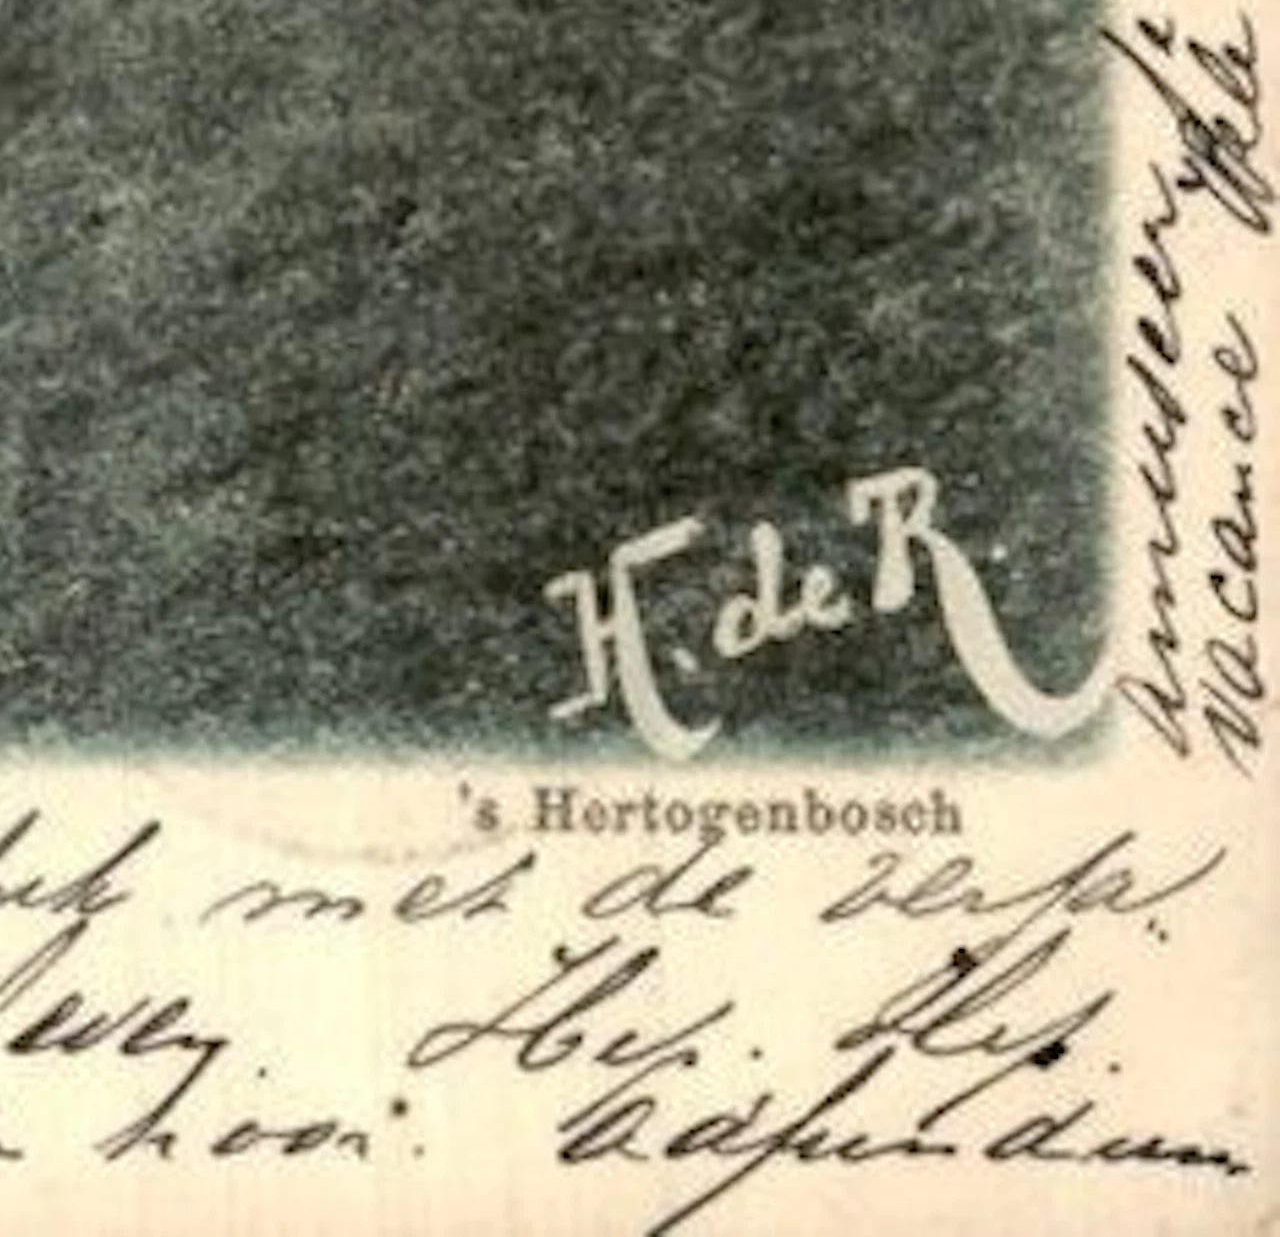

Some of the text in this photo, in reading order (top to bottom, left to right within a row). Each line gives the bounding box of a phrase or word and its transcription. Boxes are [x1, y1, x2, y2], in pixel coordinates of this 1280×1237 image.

[544, 516, 723, 761] H.
[713, 520, 852, 659] de
[530, 787, 963, 842] Hertogenbosch
[581, 827, 754, 919] de
